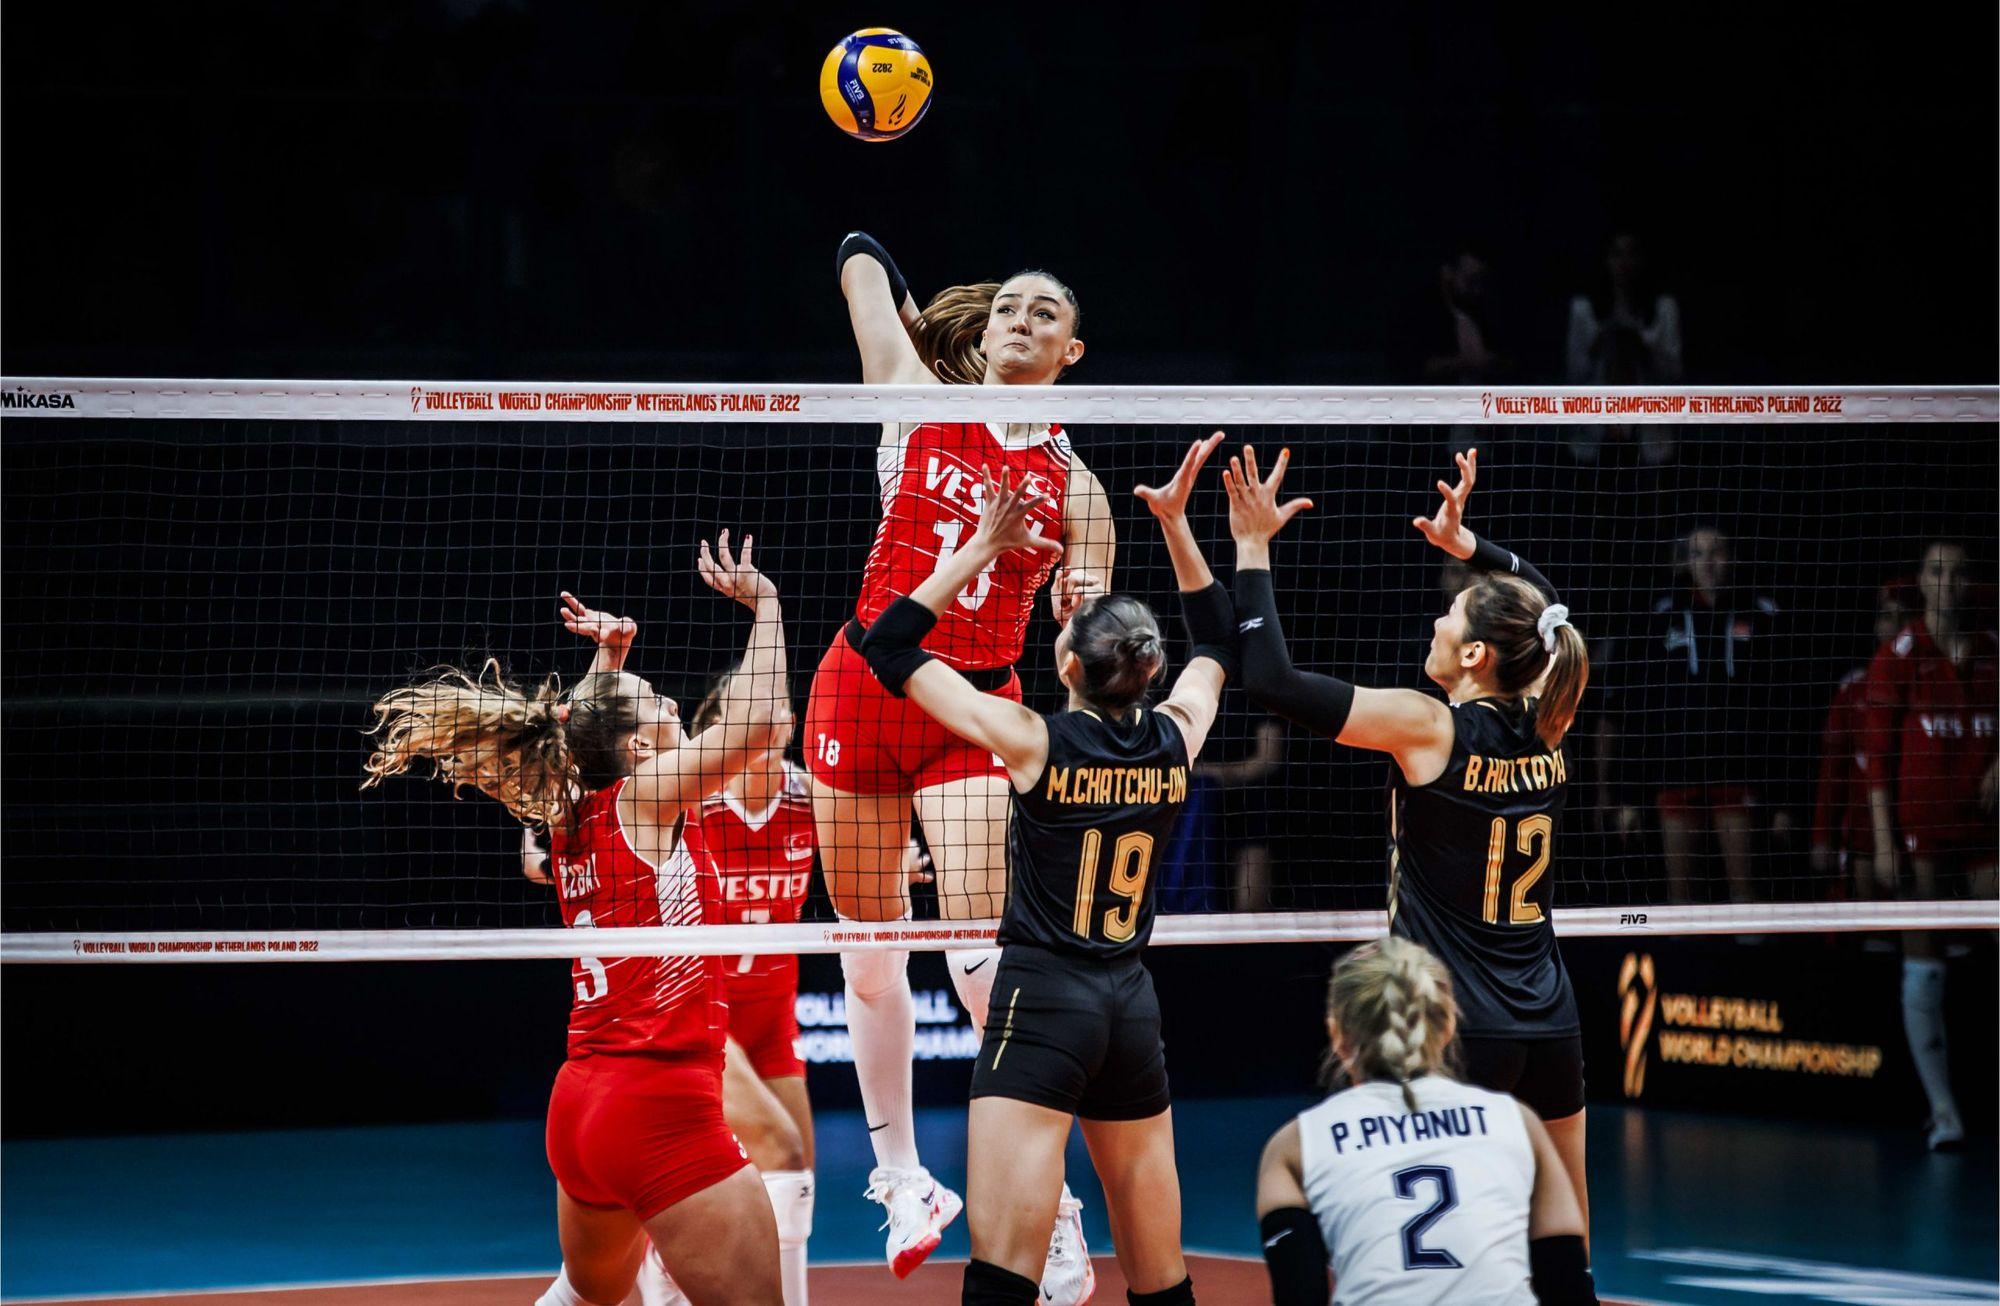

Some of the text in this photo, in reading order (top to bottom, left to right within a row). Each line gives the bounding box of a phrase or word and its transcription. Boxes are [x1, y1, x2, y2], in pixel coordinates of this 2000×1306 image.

[850, 79, 865, 100] FIVB
[1, 392, 75, 409] MIKASA
[426, 392, 800, 412] VOLLEYBALL WORLD CHAMPIONSHIP NETHERLANDS POLAND 2022
[1496, 396, 1842, 414] VOLLEYBALL WORLD CHAMPIONSHIP NETHERLANDS POLAND 2022
[818, 732, 841, 767] 18
[1046, 765, 1187, 805] M.CHATCHU-ON
[1073, 828, 1154, 943] 19
[1482, 813, 1552, 925] 12
[832, 929, 998, 943] VOLLEYBALL WORLD CHAMPIONSHIP NETHERLAND
[1620, 914, 1648, 925] FIVB
[83, 941, 319, 953] VOLLEYBALL WORLD CHAMPIONSHIP NETHERLANDS POLAND 2022
[1660, 993, 1783, 1033] VOLLEYBALL
[1658, 1030, 1882, 1078] WORLD CHAMPIONSHIP
[1330, 1106, 1487, 1154] P.PIYANUT
[1392, 1164, 1464, 1271] 2
